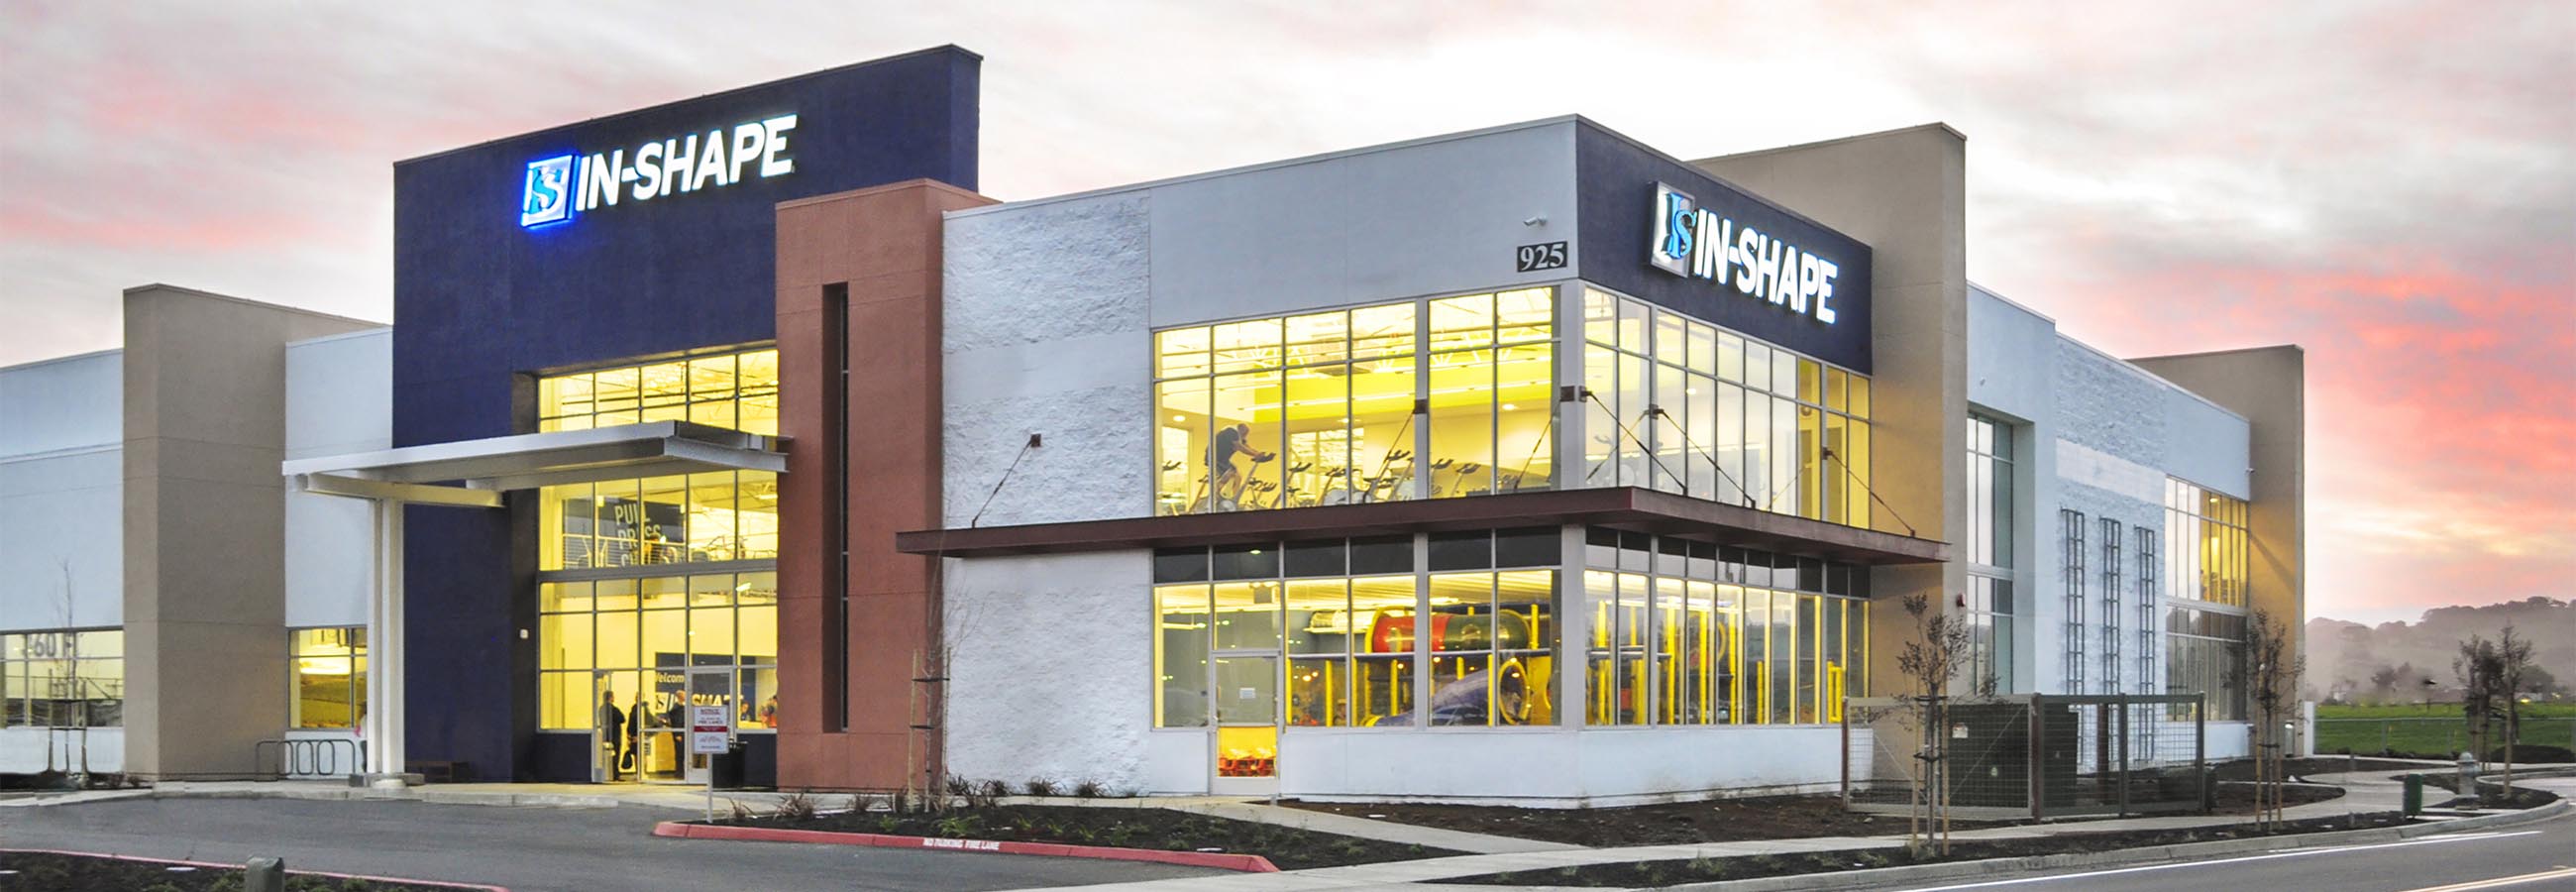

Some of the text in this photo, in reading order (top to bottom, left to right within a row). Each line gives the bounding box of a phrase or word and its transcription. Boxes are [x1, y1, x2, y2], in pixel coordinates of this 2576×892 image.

[576, 114, 797, 211] IN-SHAPE
[1520, 243, 1564, 271] 925
[1693, 208, 1838, 324] IN-SHAPE
[614, 503, 651, 525] PUL
[617, 524, 661, 550] PRSS
[655, 673, 685, 683] elcom
